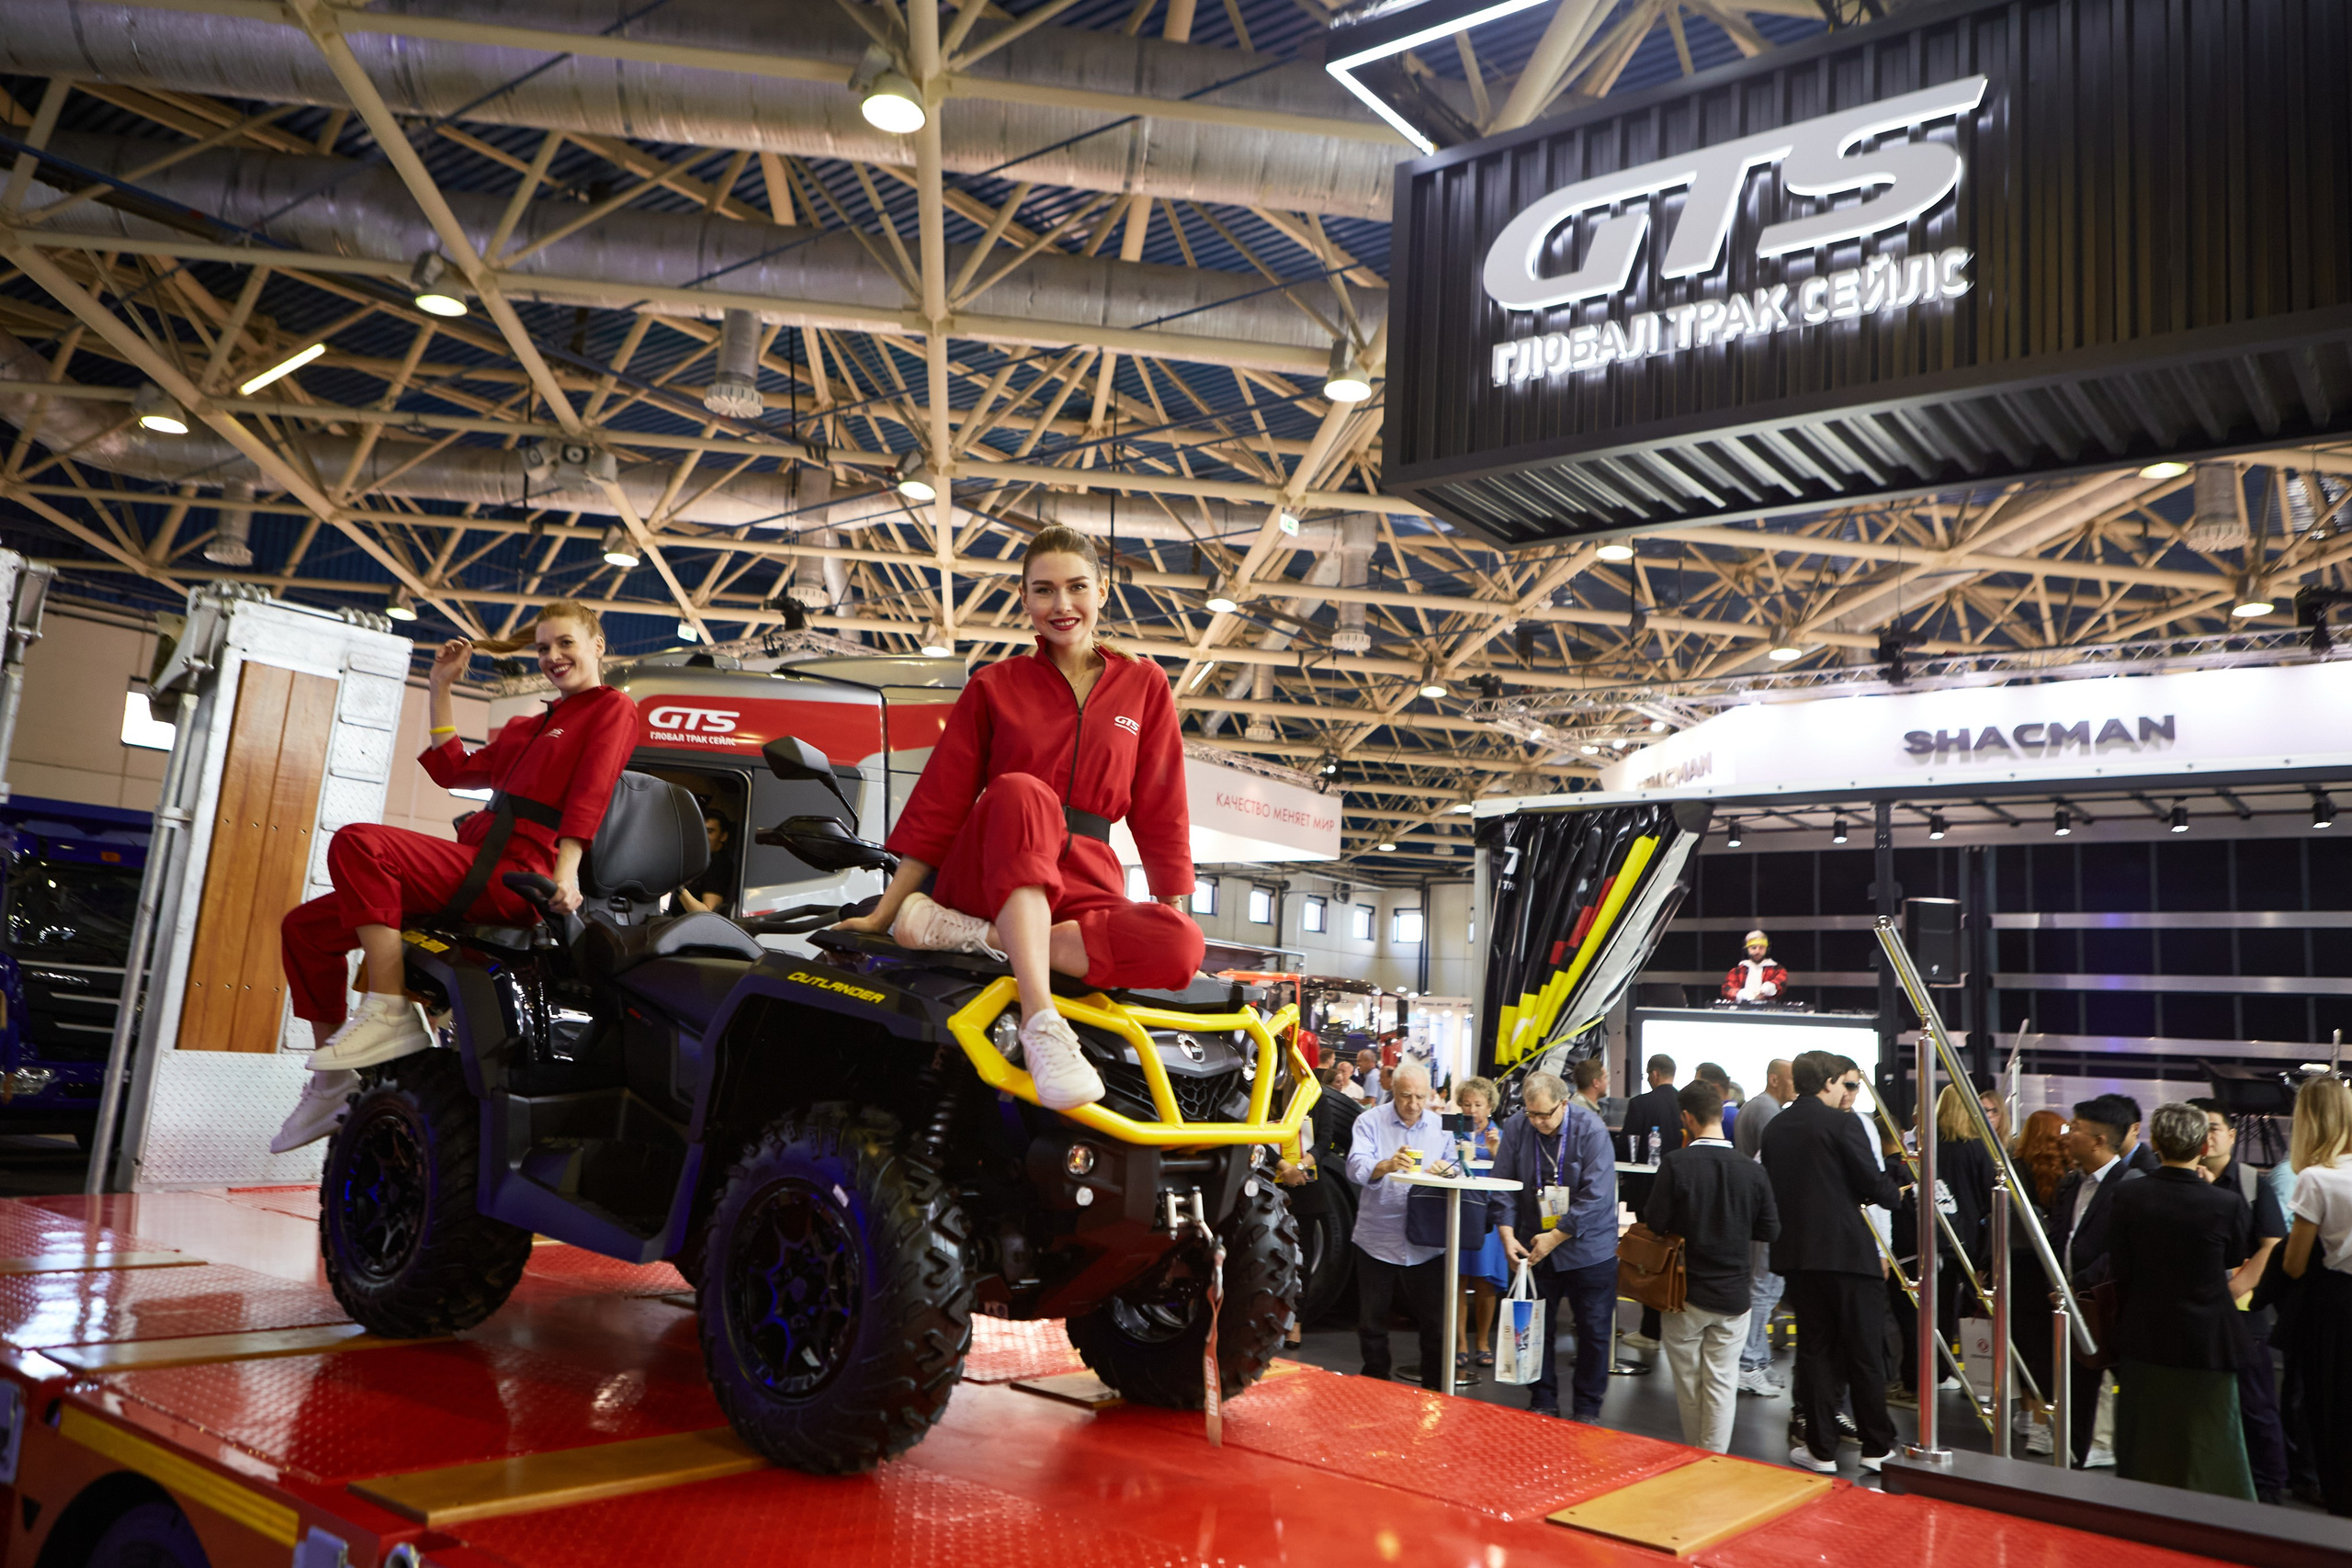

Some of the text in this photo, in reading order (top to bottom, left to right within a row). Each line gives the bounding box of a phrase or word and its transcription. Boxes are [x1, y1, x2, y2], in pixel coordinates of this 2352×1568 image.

[1483, 73, 1988, 311] GTS
[1492, 246, 1974, 387] ГЛОБАЛ ТРАК СЕЙЛС
[649, 705, 741, 733] GTS
[1114, 716, 1140, 731] GTS
[1904, 715, 2176, 755] SHACMAN
[650, 730, 737, 747] ГЛОБАЛ ТРАК СЕЙЛС
[1216, 792, 1335, 833] КАЧЕСТВО МЕНЯЕТ МИР
[786, 971, 887, 1005] OUTLANDER
